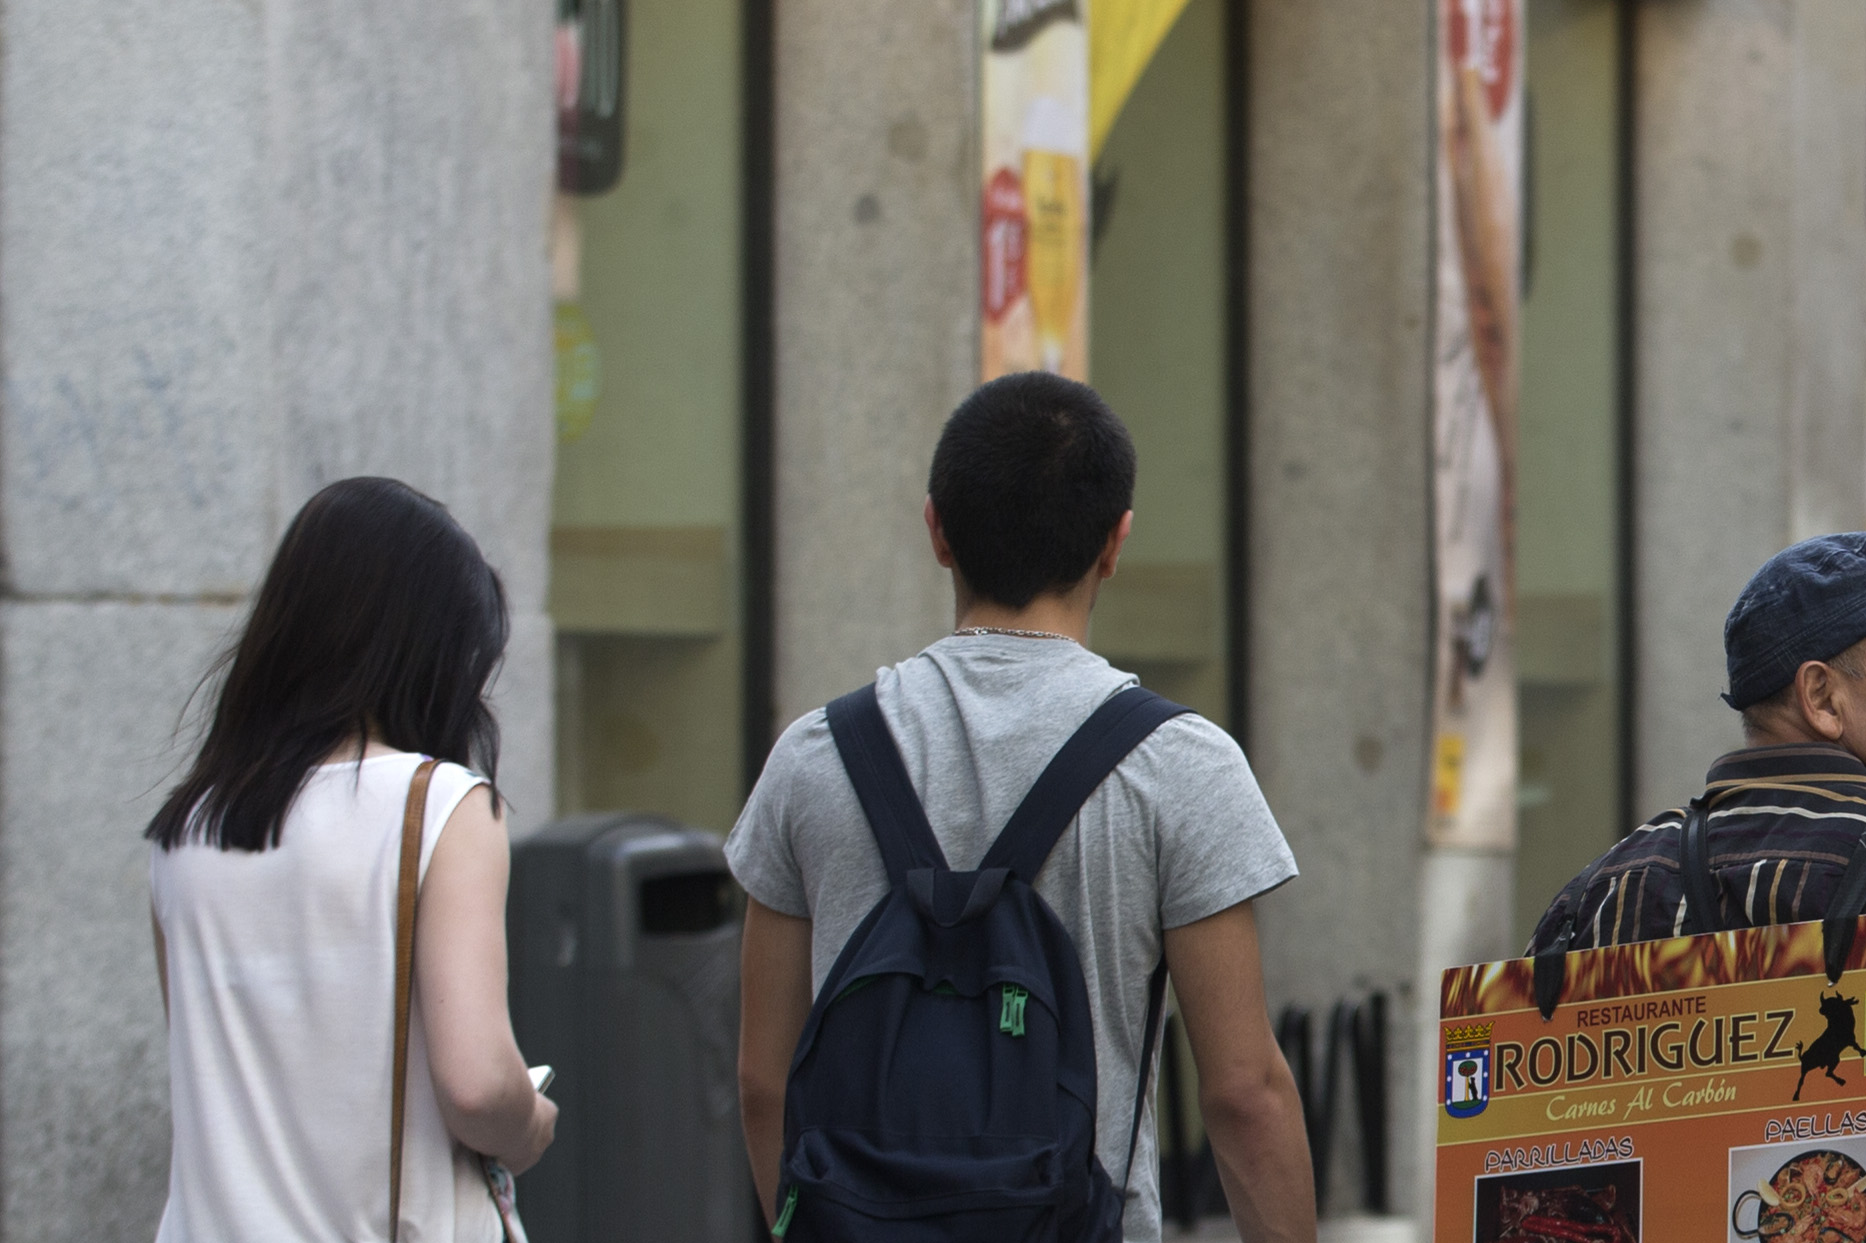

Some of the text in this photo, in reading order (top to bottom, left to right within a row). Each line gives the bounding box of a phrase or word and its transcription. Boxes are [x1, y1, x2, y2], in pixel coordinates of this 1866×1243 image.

[1577, 996, 1707, 1028] RESTAURANTE
[1494, 1009, 1796, 1092] RODRIGUEZ
[1546, 1079, 1737, 1122] Carnes Al Carbón
[1483, 1137, 1633, 1172] PARRILLADAS
